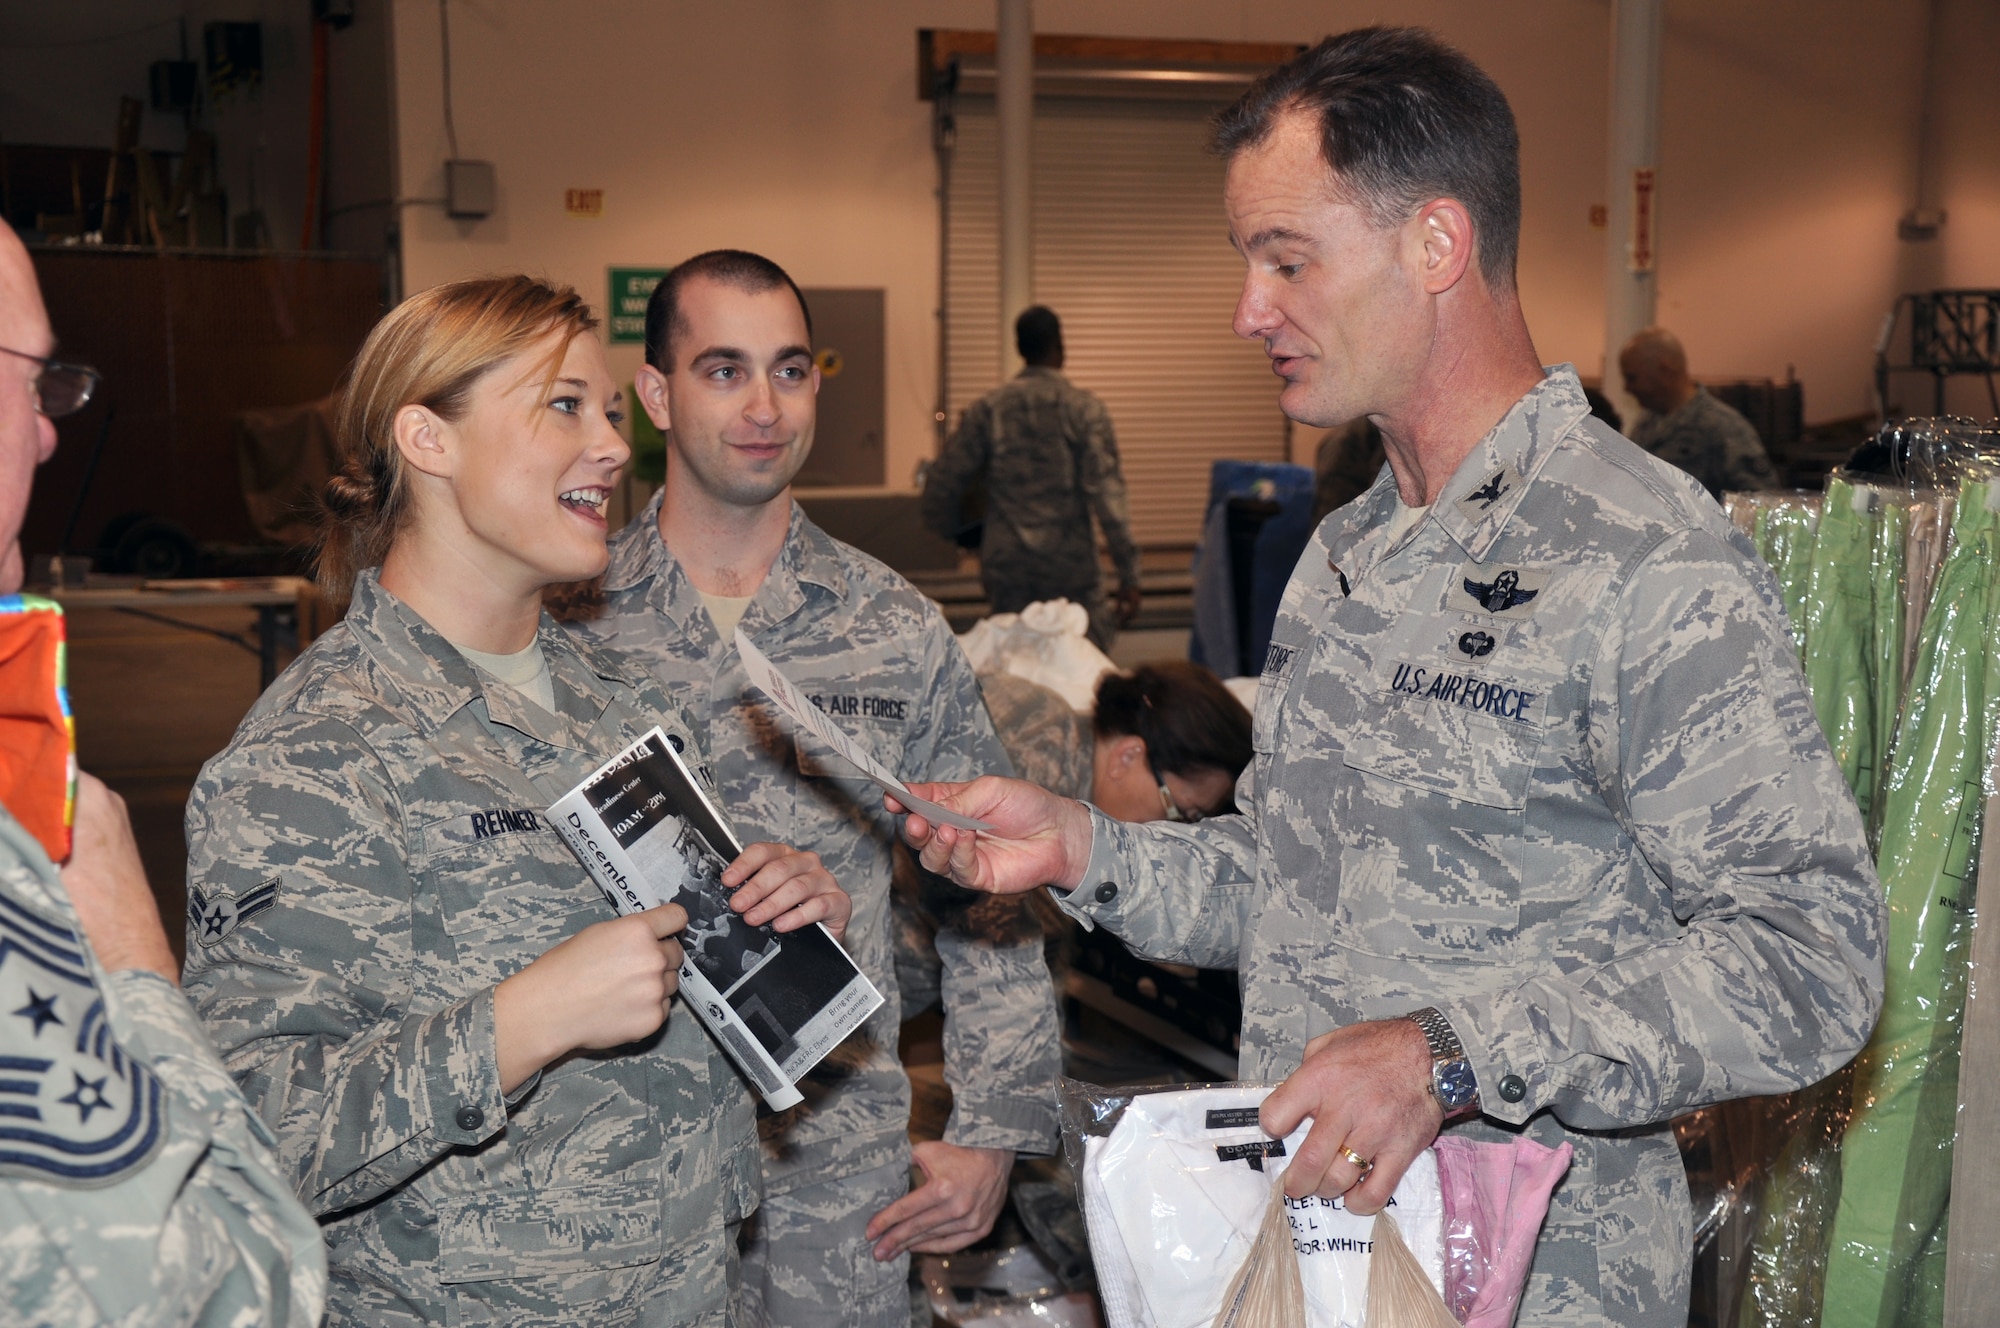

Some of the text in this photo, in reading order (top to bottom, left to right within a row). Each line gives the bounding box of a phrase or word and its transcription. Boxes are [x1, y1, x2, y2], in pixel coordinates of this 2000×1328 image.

[1392, 663, 1535, 721] U.S. AIR FORCE
[831, 696, 858, 715] AIR
[863, 697, 907, 720] FORCE
[622, 776, 642, 793] Center
[471, 809, 541, 839] REHMER
[612, 791, 666, 838] 10AM 2PM
[568, 812, 645, 911] December
[828, 988, 858, 1017] Bring your
[834, 993, 869, 1028] own camera
[1309, 1217, 1318, 1229] L
